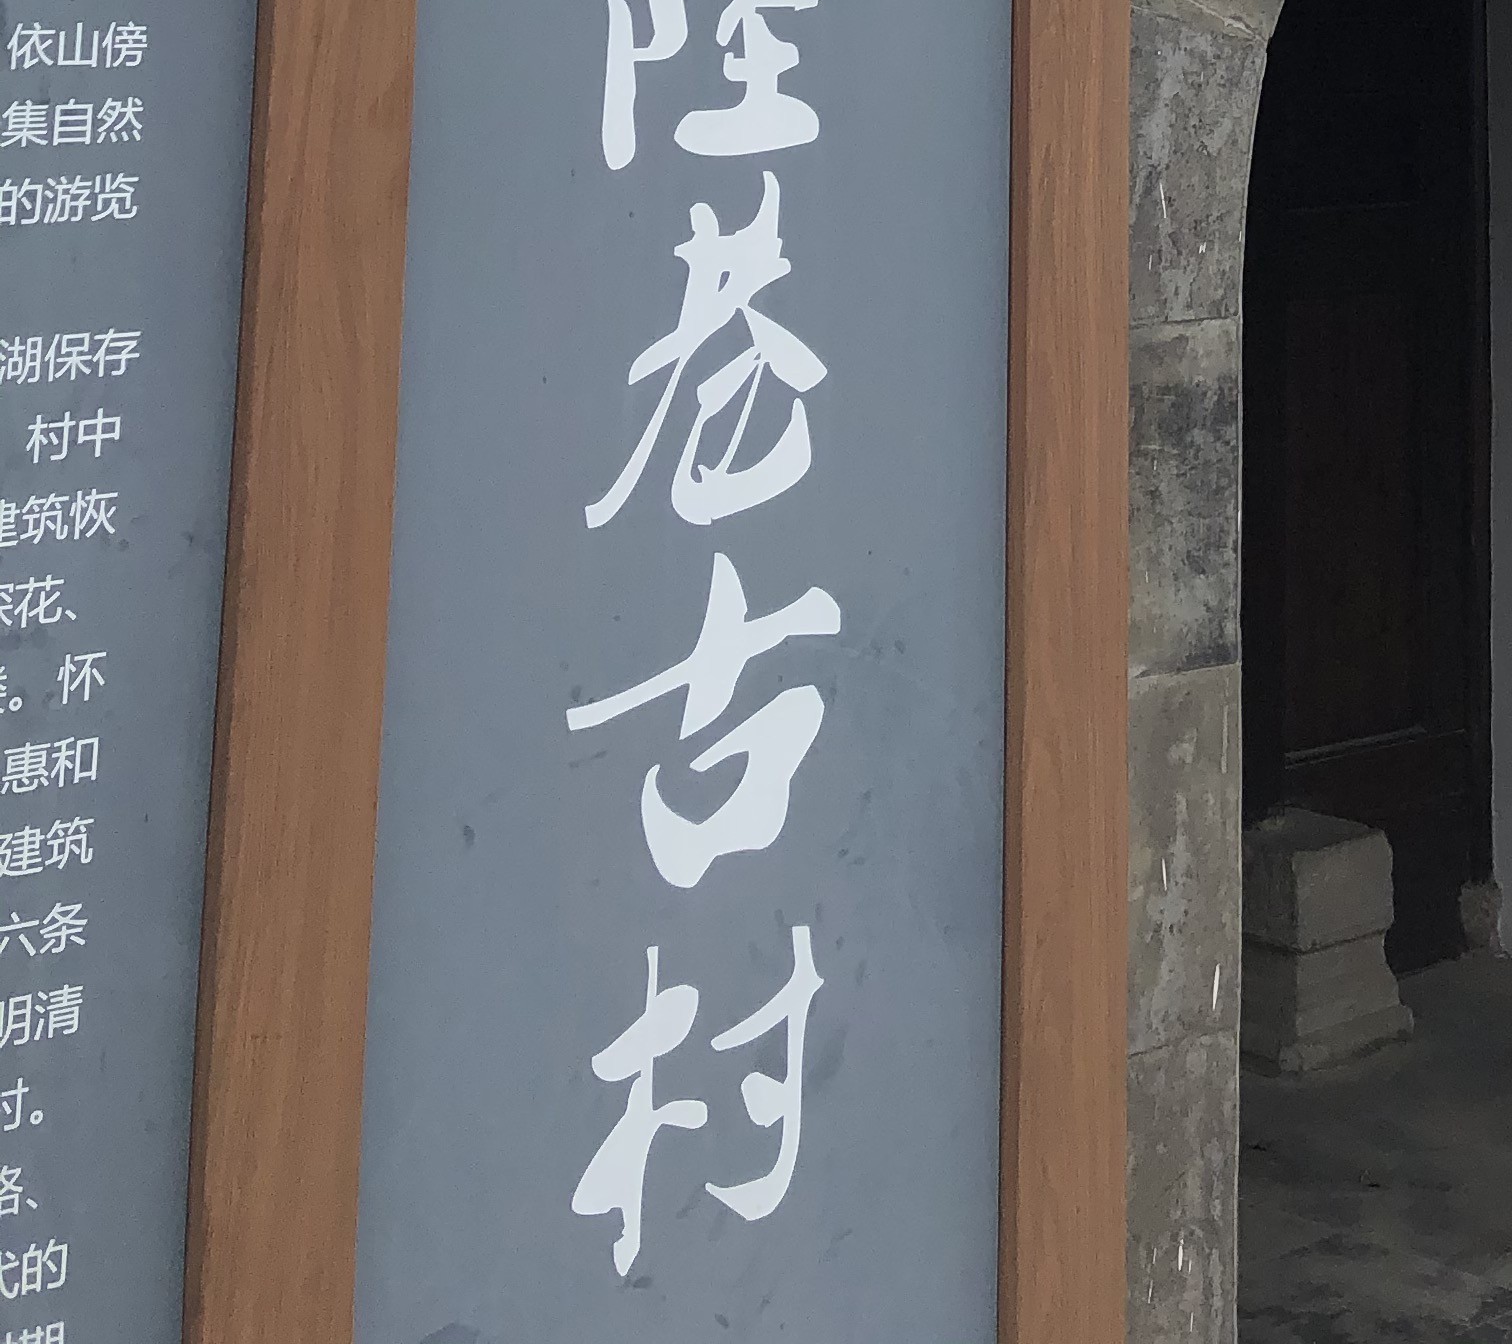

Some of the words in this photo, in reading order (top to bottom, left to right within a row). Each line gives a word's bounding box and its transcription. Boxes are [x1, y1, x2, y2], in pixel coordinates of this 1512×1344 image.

[6, 20, 149, 71] 依山傍
[0, 96, 145, 148] 集自然
[0, 172, 140, 226] 的游览
[0, 327, 142, 386] 湖保存
[25, 407, 122, 464] 村中
[0, 736, 99, 795] 惠和
[0, 816, 95, 877] 建筑
[0, 902, 88, 957] 六条
